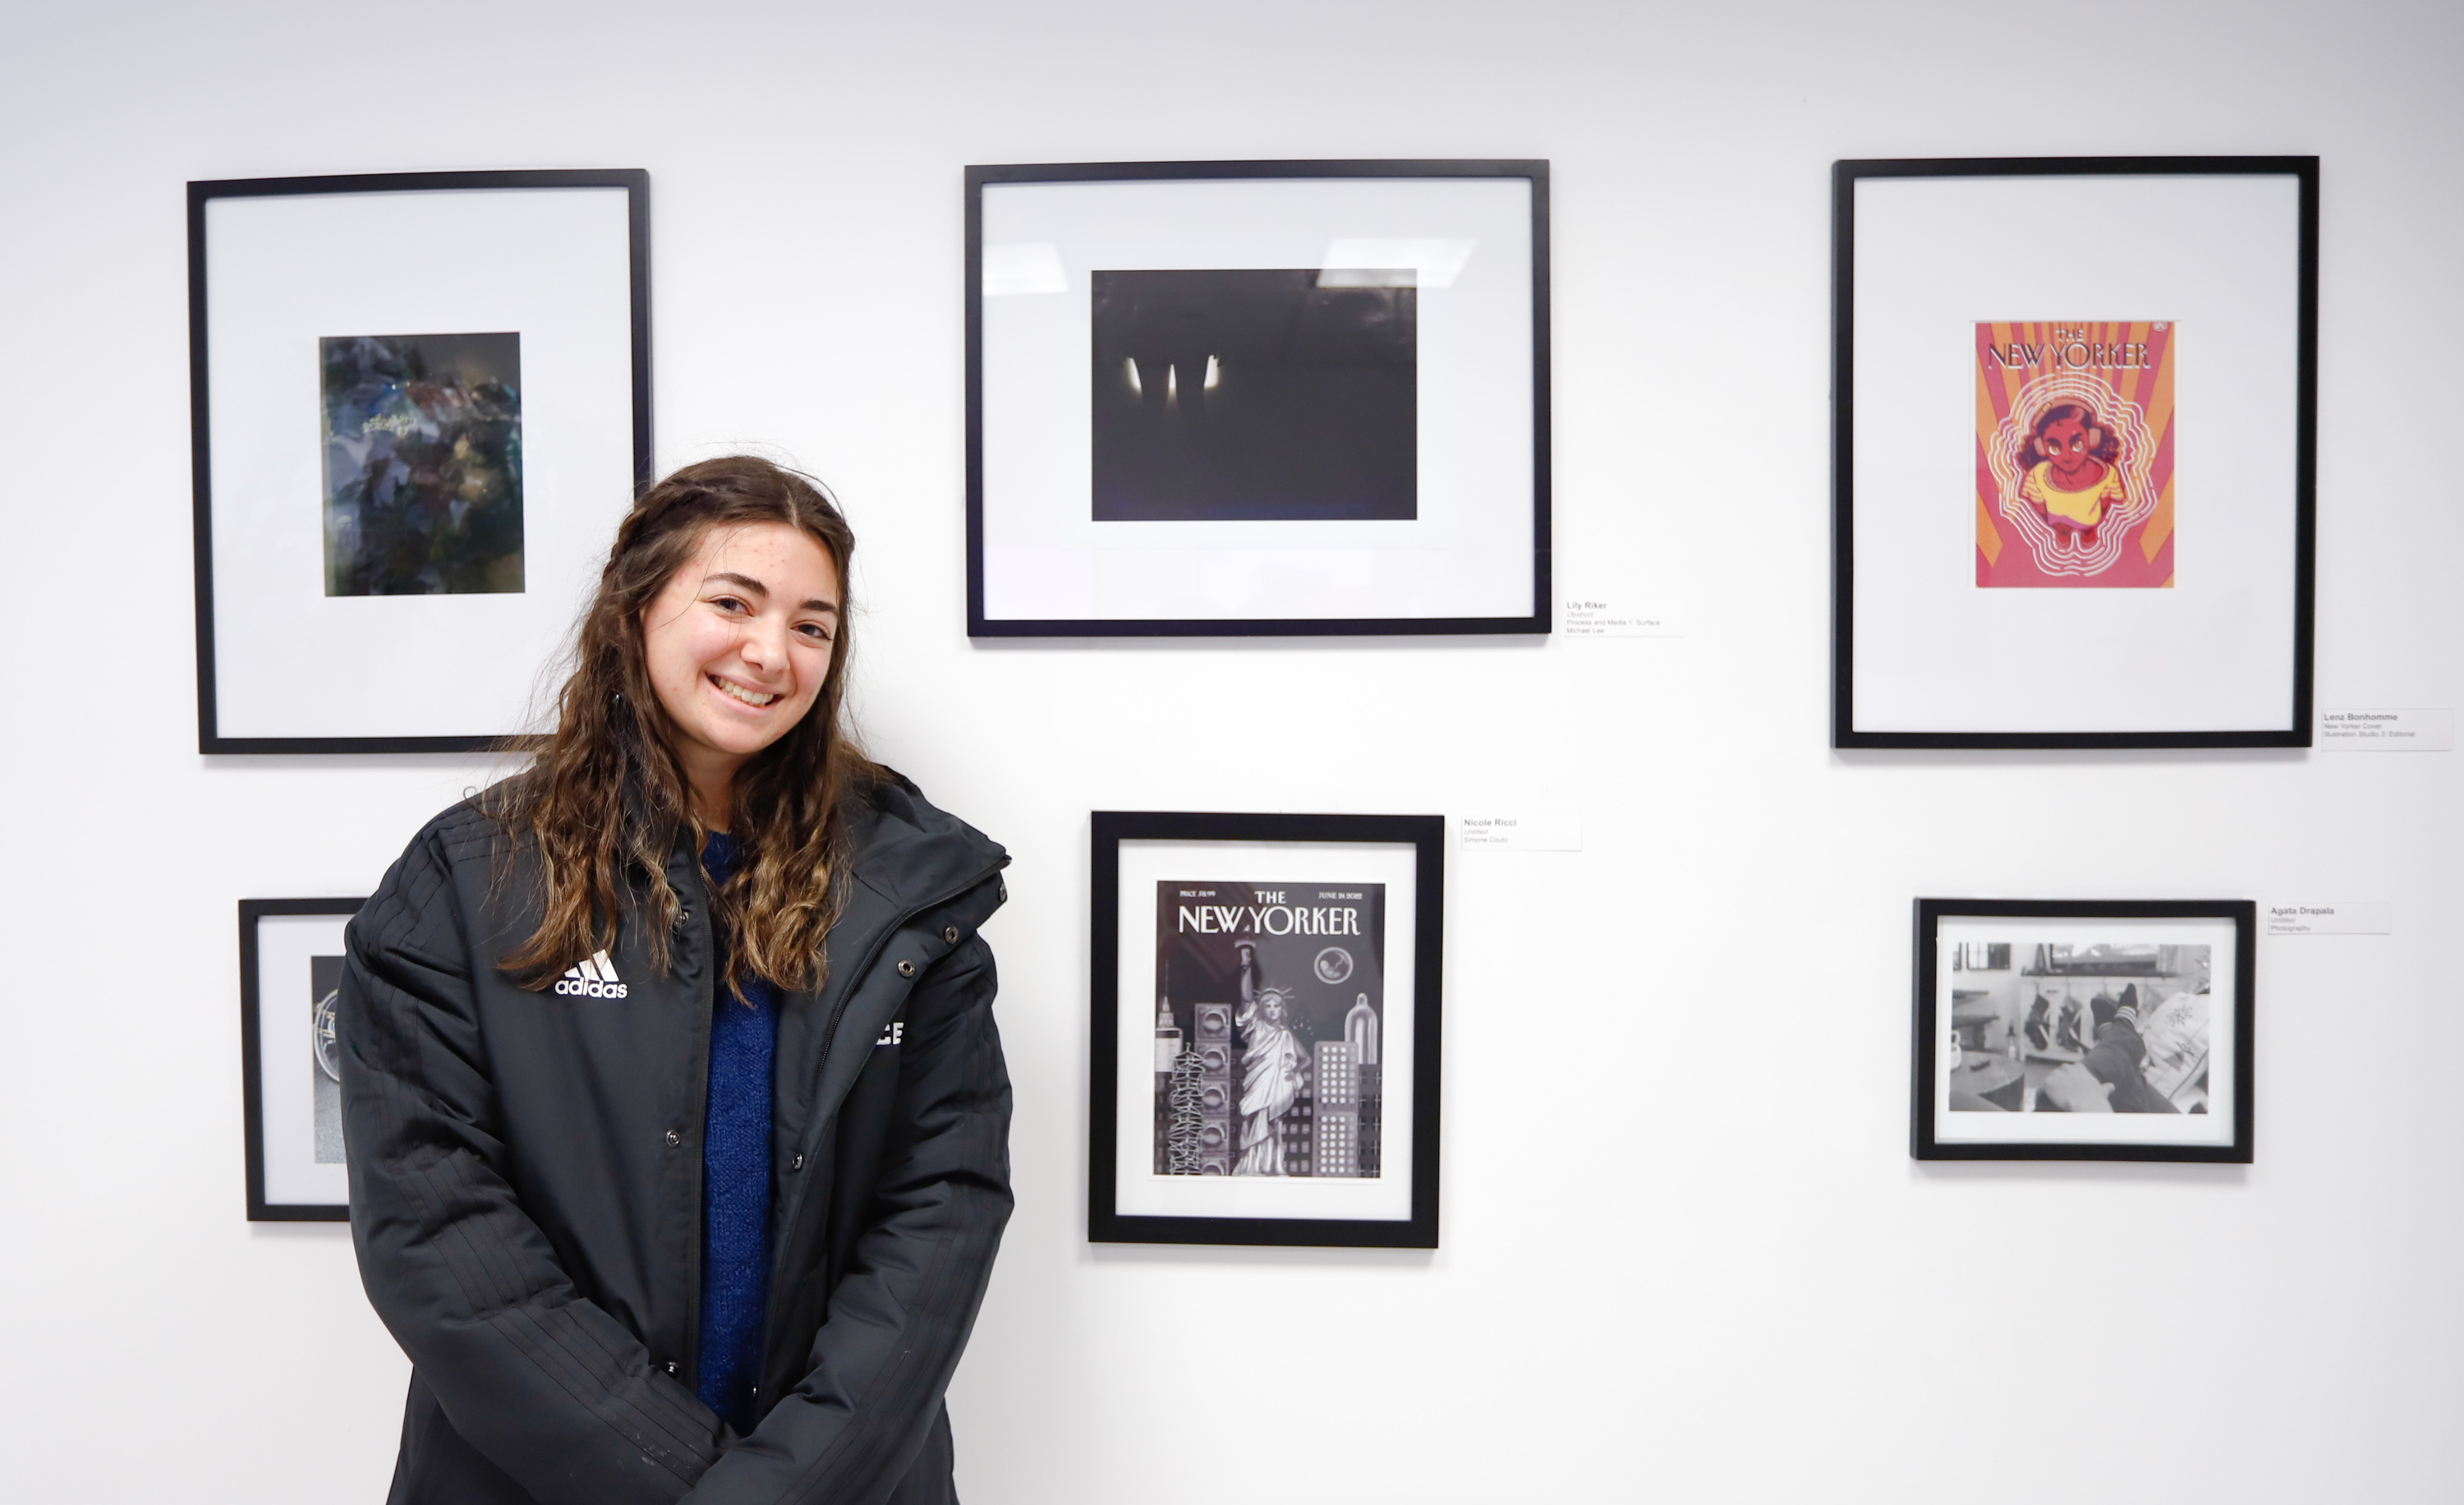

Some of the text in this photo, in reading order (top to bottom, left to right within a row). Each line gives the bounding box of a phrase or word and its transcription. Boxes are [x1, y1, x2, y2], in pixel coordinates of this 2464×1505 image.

[2056, 329, 2085, 343] THE
[1988, 343, 2152, 370] NEW YORKER
[1566, 601, 1607, 610] Lily Riker
[1464, 818, 1517, 826] Nicole Ricci
[1254, 891, 1286, 904] THE
[1318, 891, 1337, 900] JUNE
[2270, 907, 2296, 916] Agata
[1179, 905, 1361, 936] NEW YORKER
[554, 978, 628, 1000] adidas
